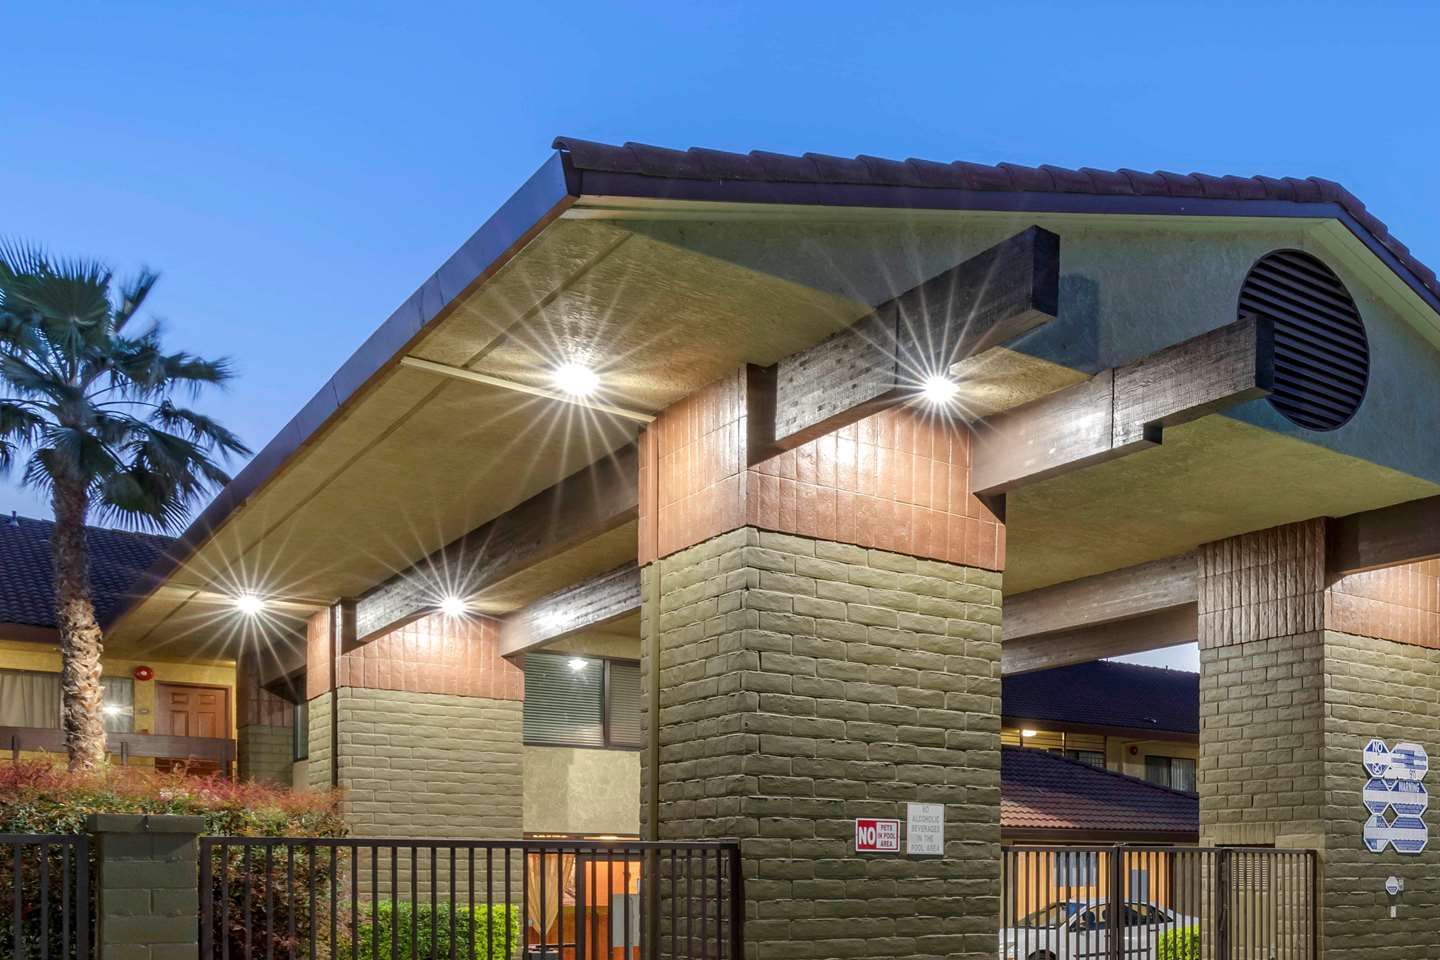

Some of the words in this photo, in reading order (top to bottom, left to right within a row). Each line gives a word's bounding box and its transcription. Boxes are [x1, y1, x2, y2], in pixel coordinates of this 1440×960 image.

[1372, 741, 1383, 753] NO
[912, 815, 940, 823] ALCOHOLIC
[858, 827, 876, 845] NO
